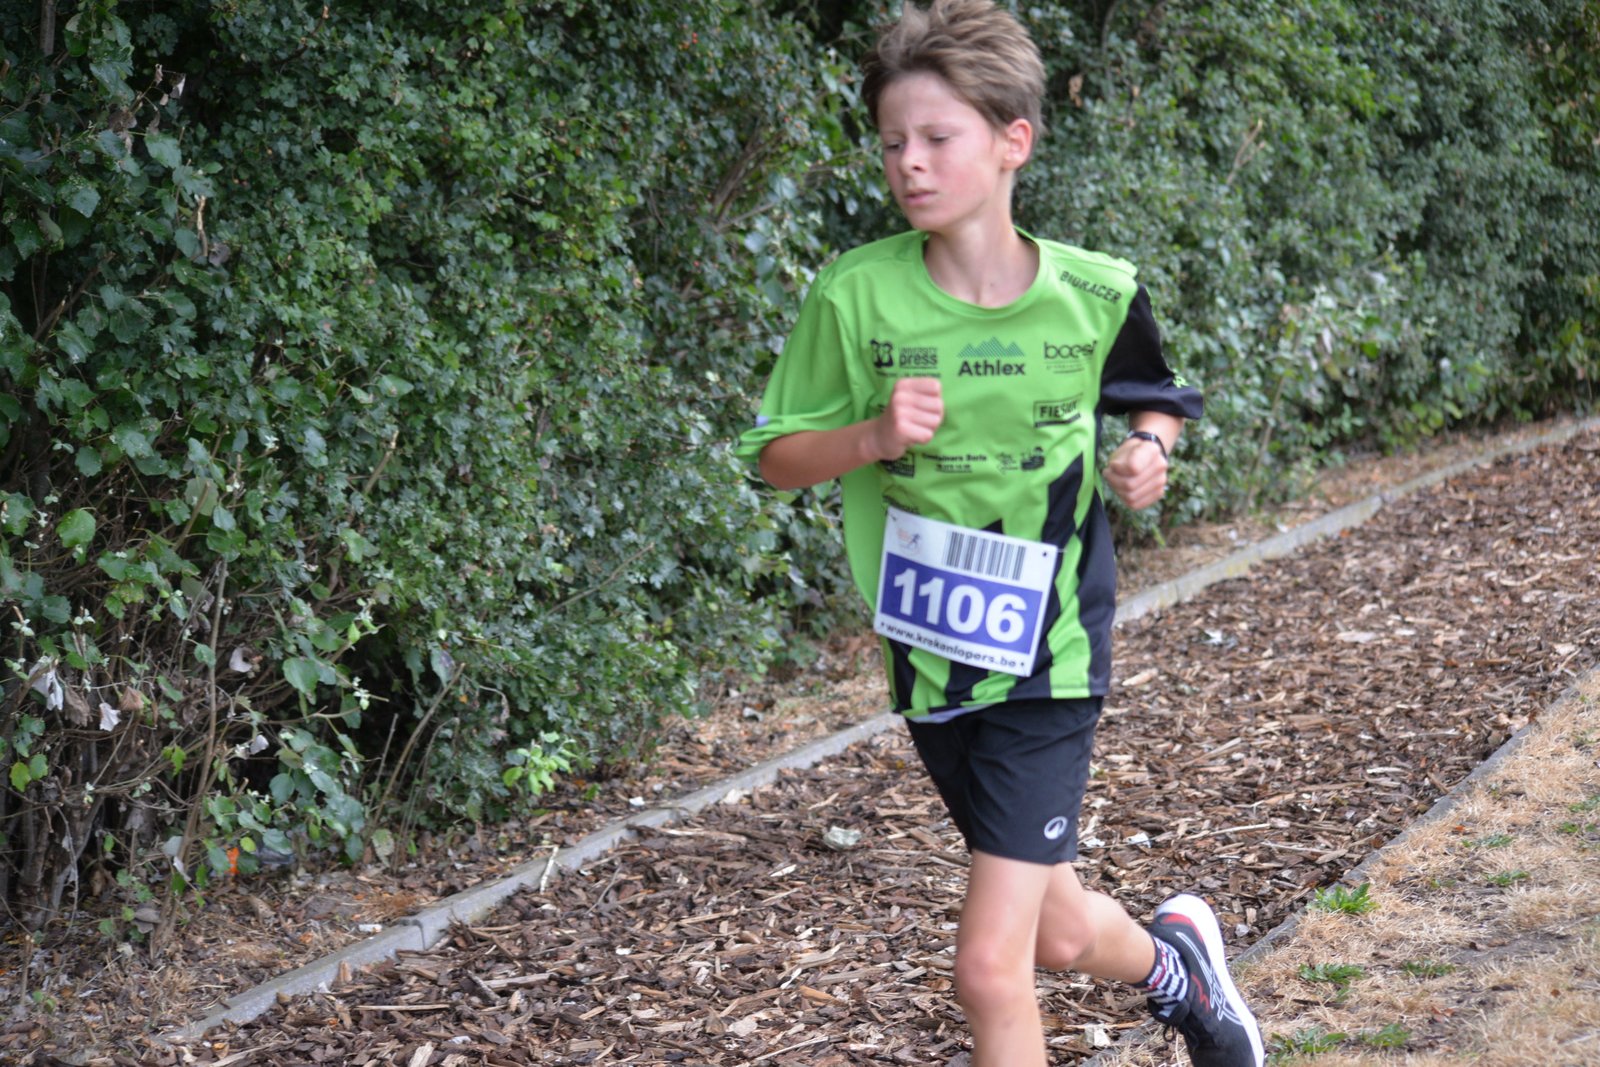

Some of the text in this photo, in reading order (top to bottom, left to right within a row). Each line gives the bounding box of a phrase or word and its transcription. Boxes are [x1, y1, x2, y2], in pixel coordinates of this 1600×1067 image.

[1060, 271, 1122, 304] BIORACER
[899, 353, 938, 367] press
[958, 359, 1025, 377] Athlex
[894, 568, 1027, 643] 1106
